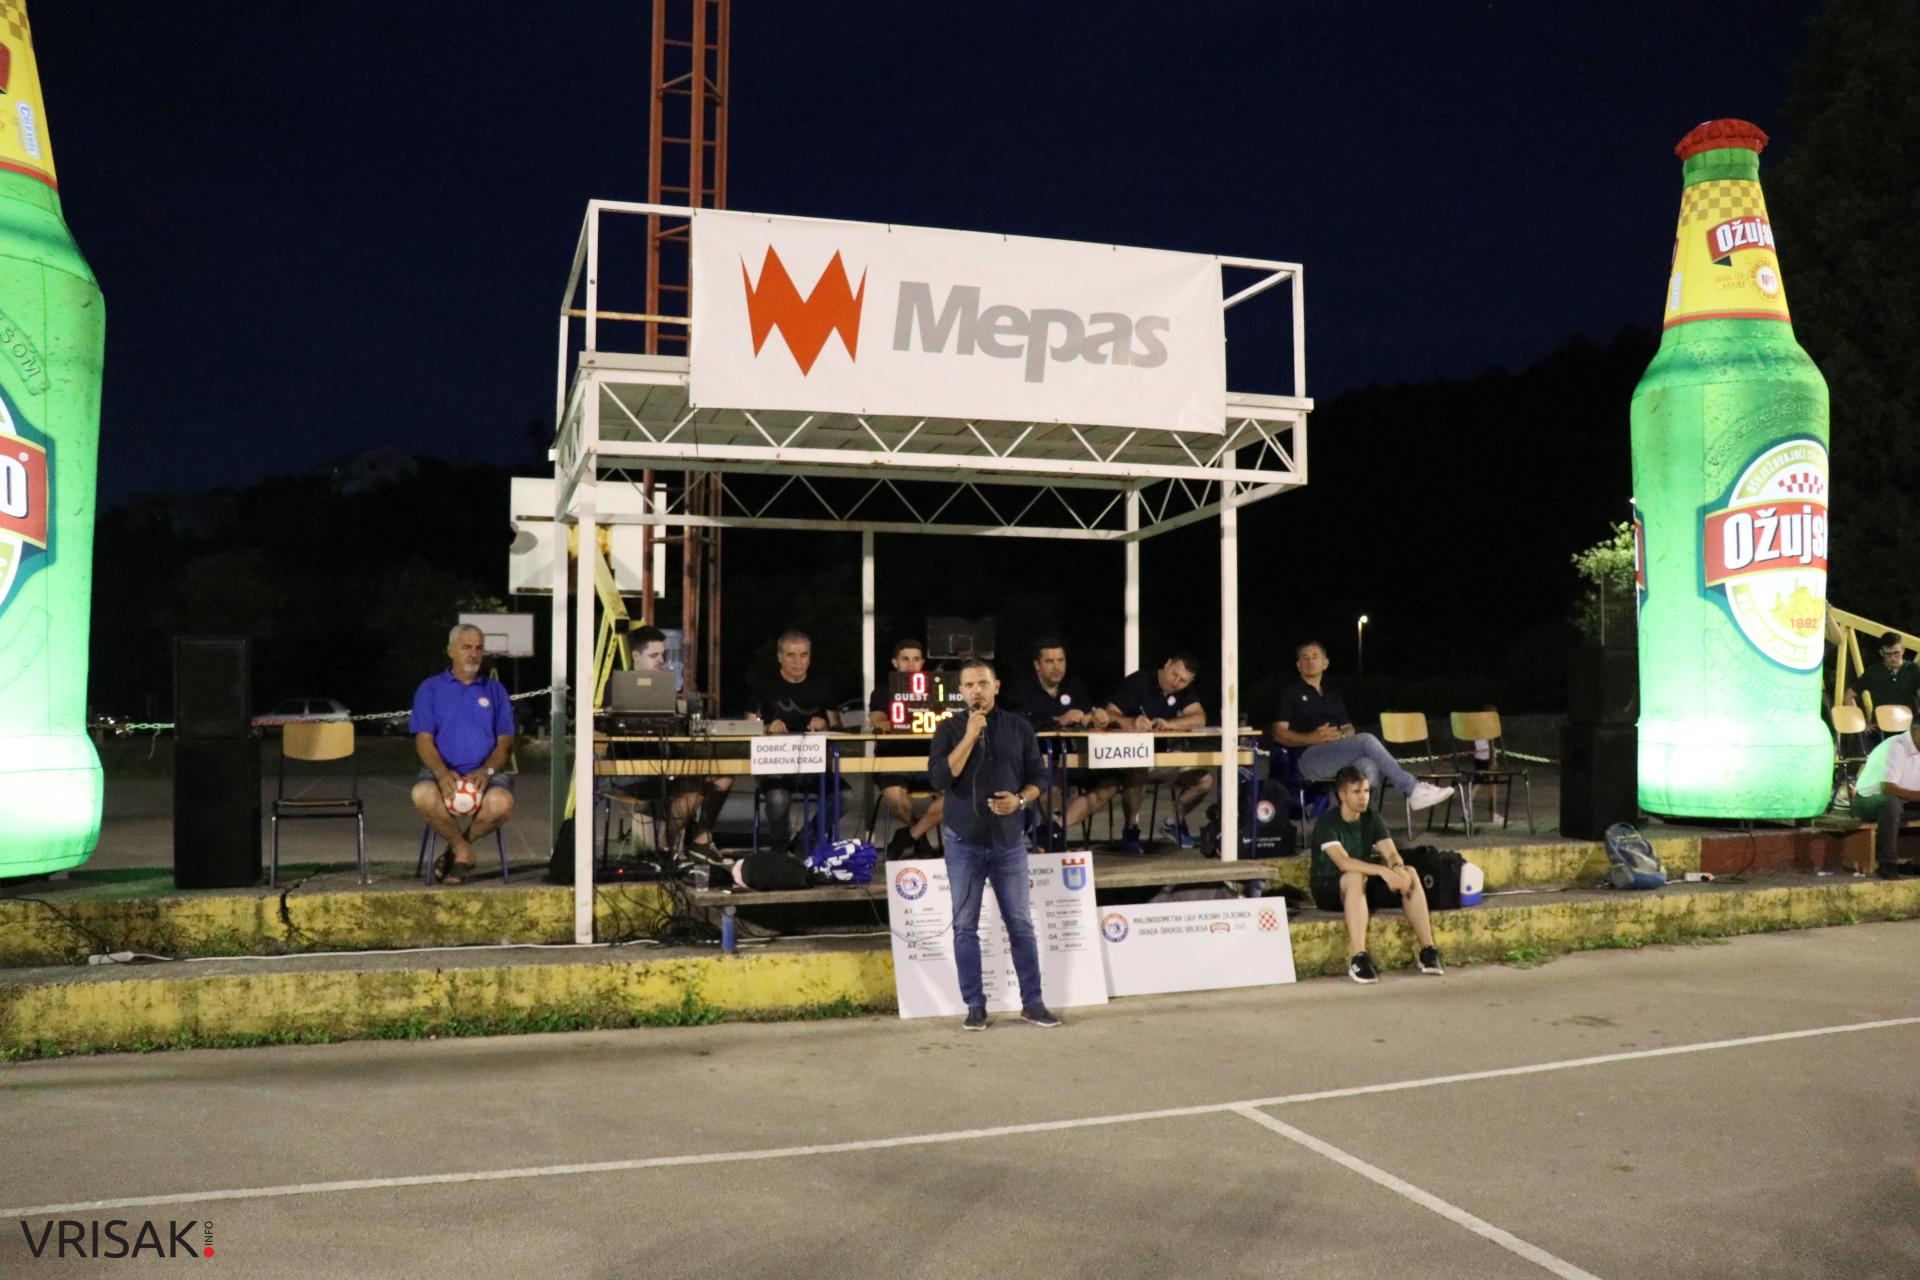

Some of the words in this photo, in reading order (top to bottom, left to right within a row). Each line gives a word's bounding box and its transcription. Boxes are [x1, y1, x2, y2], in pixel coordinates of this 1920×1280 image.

[893, 281, 1170, 383] Mepas
[1723, 505, 1828, 570] Ožujs
[1790, 617, 1819, 629] 1892
[912, 672, 926, 694] 0
[894, 692, 928, 701] GUEST
[948, 693, 963, 701] HO
[891, 702, 904, 723] 0
[912, 711, 953, 733] 20:
[792, 743, 820, 752] PROVO
[758, 757, 795, 765] GRABOVA
[797, 756, 823, 765] DRAGA
[1026, 867, 1055, 876] AJEDNICA
